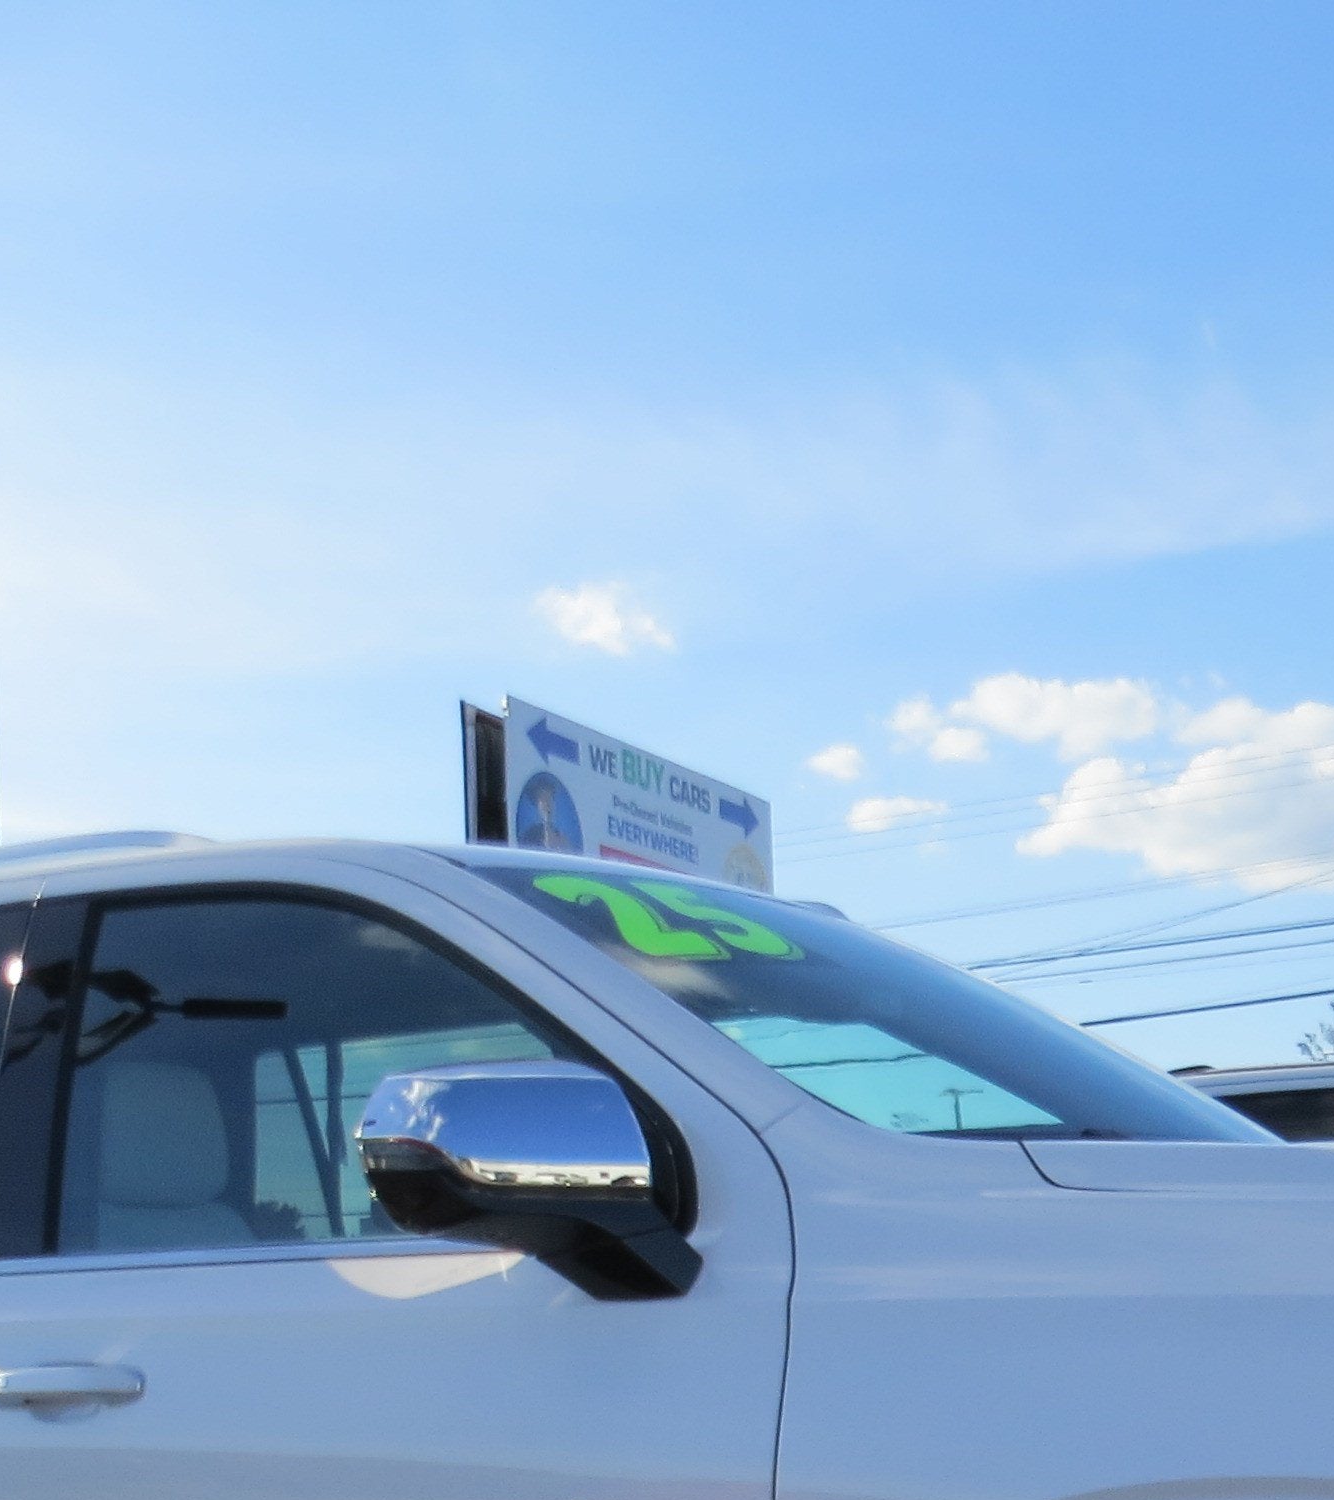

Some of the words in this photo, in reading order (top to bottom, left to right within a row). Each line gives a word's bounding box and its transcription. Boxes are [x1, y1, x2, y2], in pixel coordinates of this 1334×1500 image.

[588, 743, 618, 779] WE
[621, 748, 666, 795] BUY
[669, 775, 711, 814] CARS
[532, 870, 806, 961] 25
